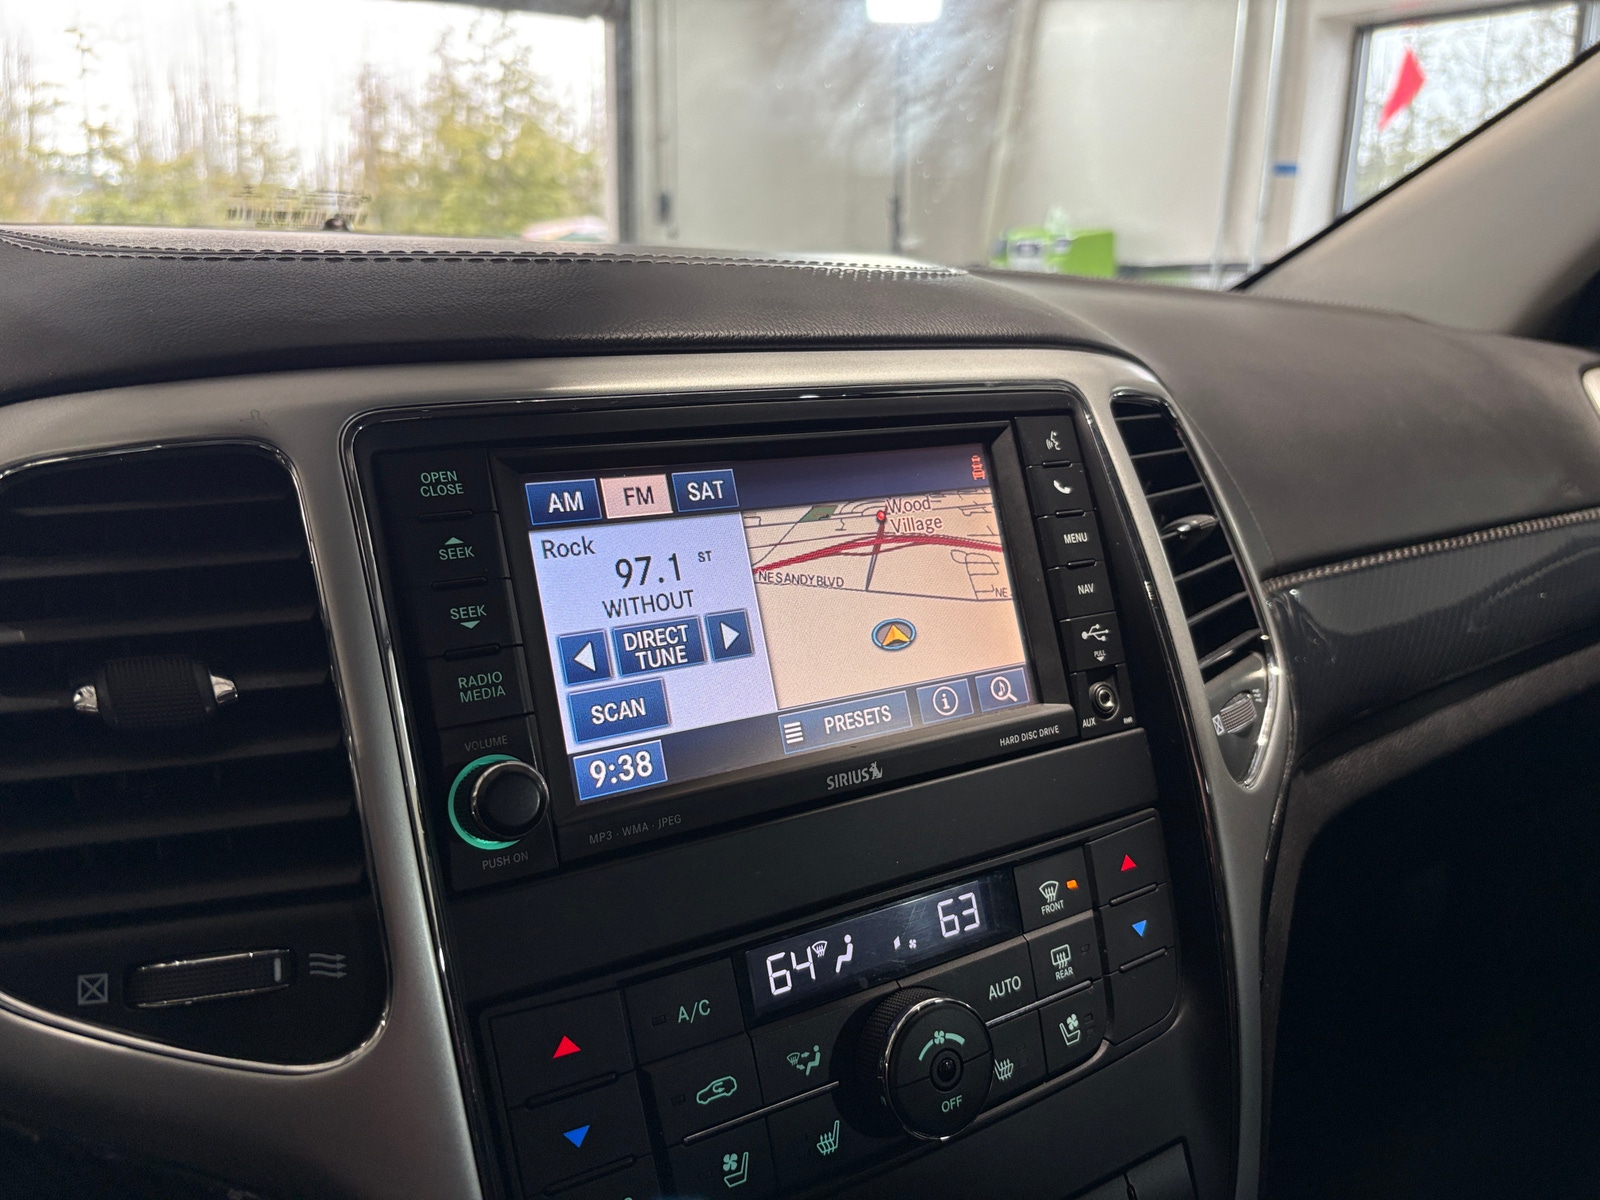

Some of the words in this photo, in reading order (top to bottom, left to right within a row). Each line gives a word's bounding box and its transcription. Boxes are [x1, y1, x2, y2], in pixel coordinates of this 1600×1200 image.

[420, 470, 458, 484] OPEN
[420, 483, 464, 497] CLOSE
[623, 486, 655, 506] FM
[687, 480, 724, 501] SAT
[548, 491, 584, 513] AM
[886, 495, 931, 514] Wood
[889, 516, 943, 534] Village
[540, 536, 596, 559] Rock
[1063, 532, 1088, 544] MENU
[438, 546, 475, 561] SEEK
[697, 550, 712, 562] ST
[615, 552, 682, 589] 97.1
[995, 587, 1009, 598] NE
[1077, 583, 1094, 595] NAV
[450, 604, 488, 620] SEEK
[602, 589, 694, 619] WITHOUT
[622, 624, 689, 652] DIRECT
[634, 645, 689, 671] TUNE
[1093, 649, 1107, 658] PULL
[457, 670, 503, 689] RADIO
[459, 685, 507, 704] MEDIA
[591, 697, 646, 725] SCAN
[823, 705, 892, 734] PRESETS
[1082, 716, 1097, 728] AUX
[463, 735, 508, 752] VOLUME
[999, 734, 1020, 747] HARD
[1021, 729, 1038, 742] DISC
[1039, 724, 1060, 738] DRIVE
[589, 750, 653, 789] 9:38
[826, 769, 871, 791] SIRIUS
[588, 832, 614, 845] MP3
[621, 821, 650, 837] WMA
[657, 814, 682, 830] JPEG
[481, 856, 511, 871] PUSH
[512, 851, 530, 864] ON
[936, 891, 981, 938] 63
[1040, 899, 1065, 915] FRONT
[765, 945, 816, 996] 64
[1054, 965, 1074, 980] REAR
[988, 975, 1022, 1000] AUTO
[677, 999, 711, 1024] A/C
[940, 1095, 964, 1113] OFF
